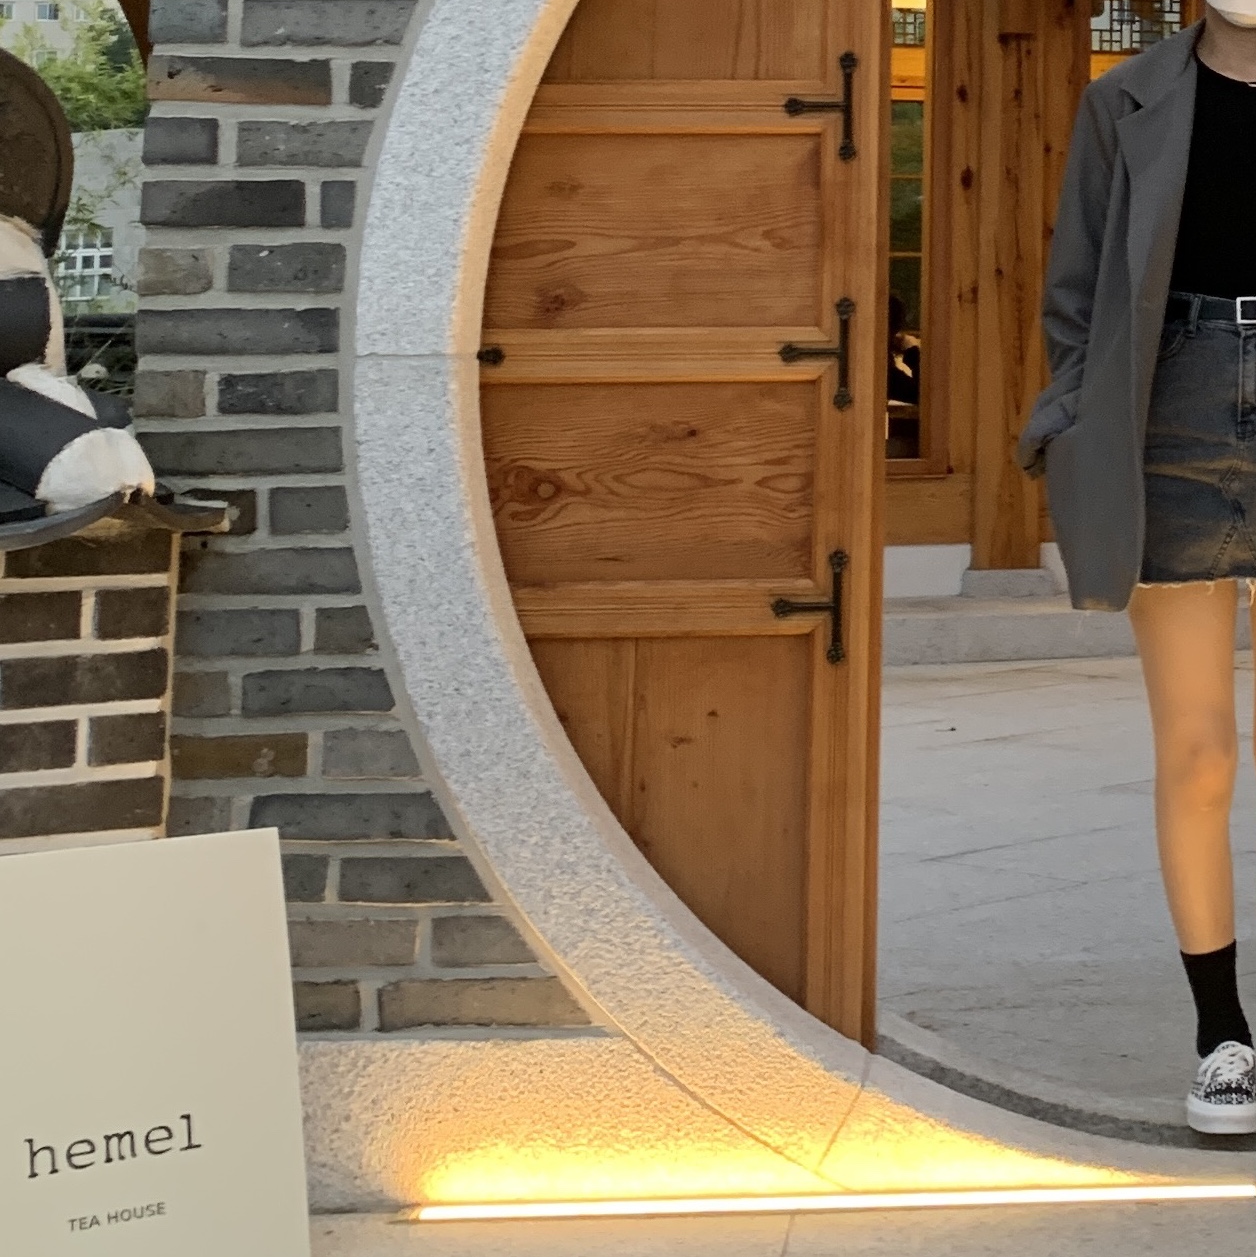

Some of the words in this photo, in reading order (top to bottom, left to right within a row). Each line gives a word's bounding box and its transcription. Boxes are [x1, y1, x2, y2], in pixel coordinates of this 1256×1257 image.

[24, 1113, 202, 1179] hemel
[68, 1215, 100, 1232] TEA
[107, 1202, 166, 1225] HOUSE
